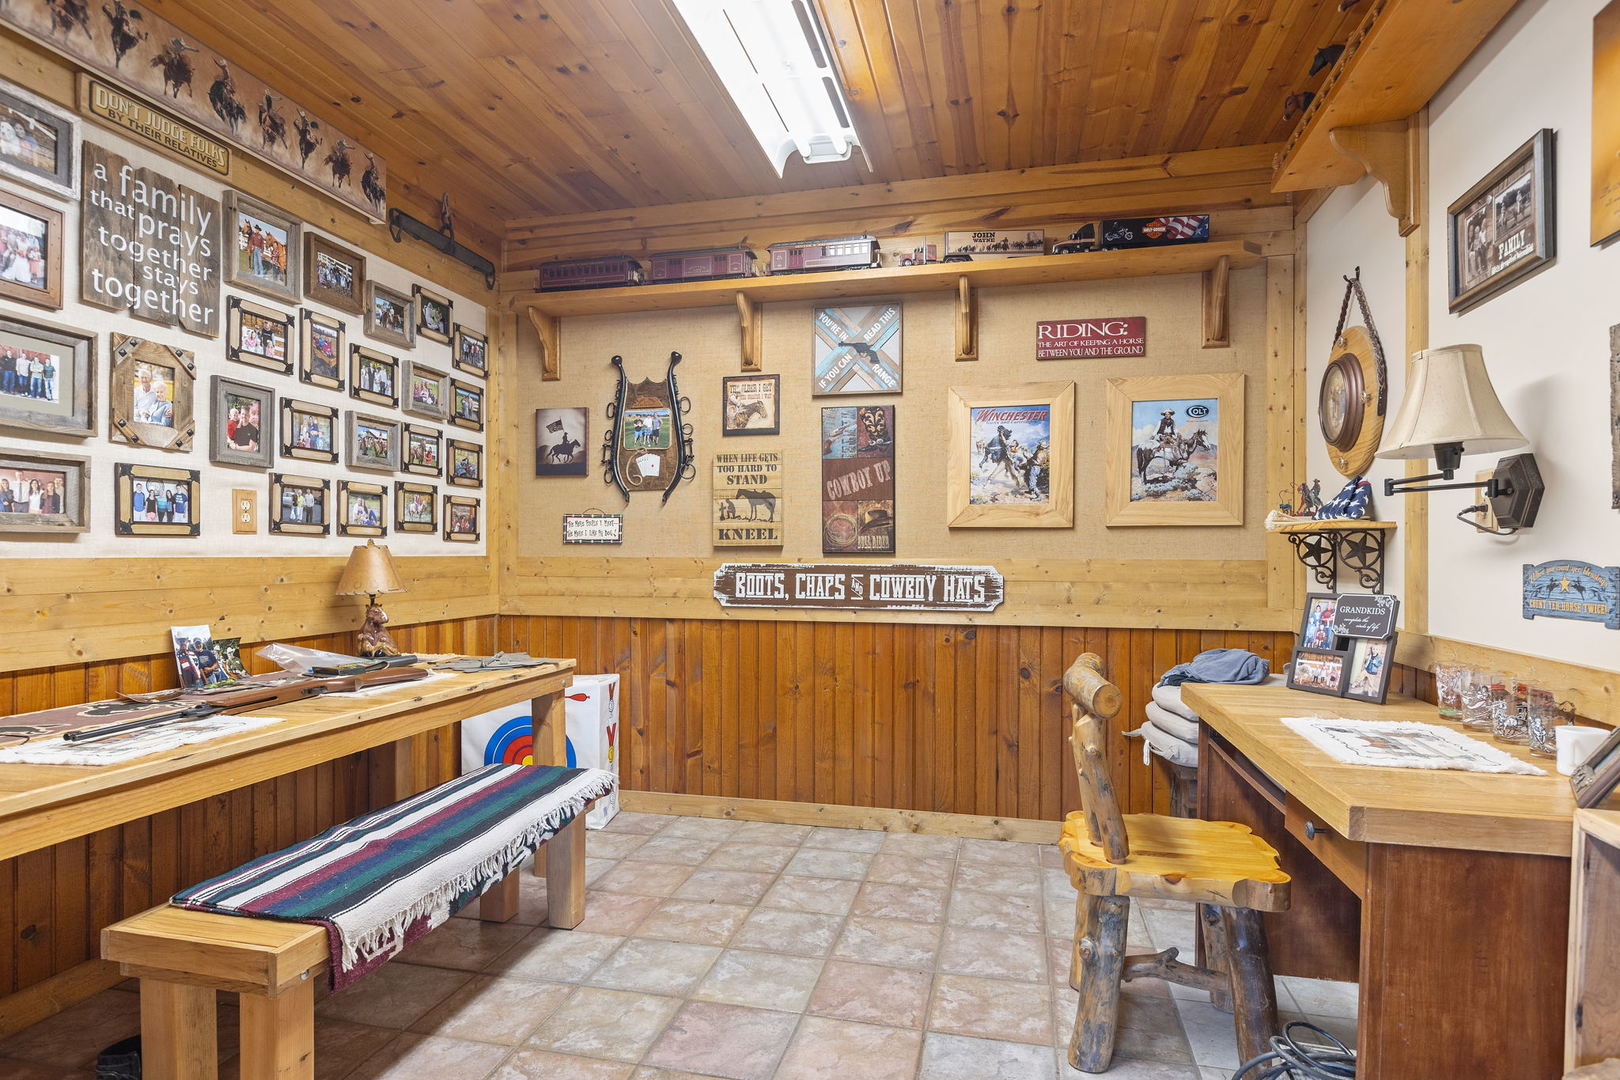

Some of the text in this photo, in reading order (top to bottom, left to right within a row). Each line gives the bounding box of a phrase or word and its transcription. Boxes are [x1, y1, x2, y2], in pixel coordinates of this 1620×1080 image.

[95, 87, 225, 166] DON'T JUDGE FOLKS
[108, 108, 218, 168] BY THEIR RELATIVES
[94, 163, 212, 236] a family
[90, 189, 211, 257] that prays
[98, 225, 212, 282] together
[1499, 229, 1526, 260] FAMILY
[142, 265, 199, 296] stays
[91, 268, 213, 325] together
[1038, 321, 1129, 339] RIDING:
[818, 307, 896, 389] IF YOU CAN READ THIS
[818, 311, 897, 388] YOU'RE IN RANGE
[1038, 345, 1144, 358] BETWEEN YOU AND THE GROUND
[975, 408, 1048, 422] WINCHESTER
[1188, 406, 1207, 417] COLT
[716, 453, 778, 463] WHEN LIFE GETS
[717, 464, 777, 473] TOO HARD TO
[726, 474, 768, 485] STAND
[826, 460, 891, 500] COWBOY UP
[718, 528, 778, 540] KNEEL
[735, 572, 789, 601] BOOTS,
[795, 573, 845, 600] CHAPS
[869, 574, 937, 601] COWBOY
[943, 575, 985, 603] HATS
[1340, 605, 1386, 615] GRANDKIDS
